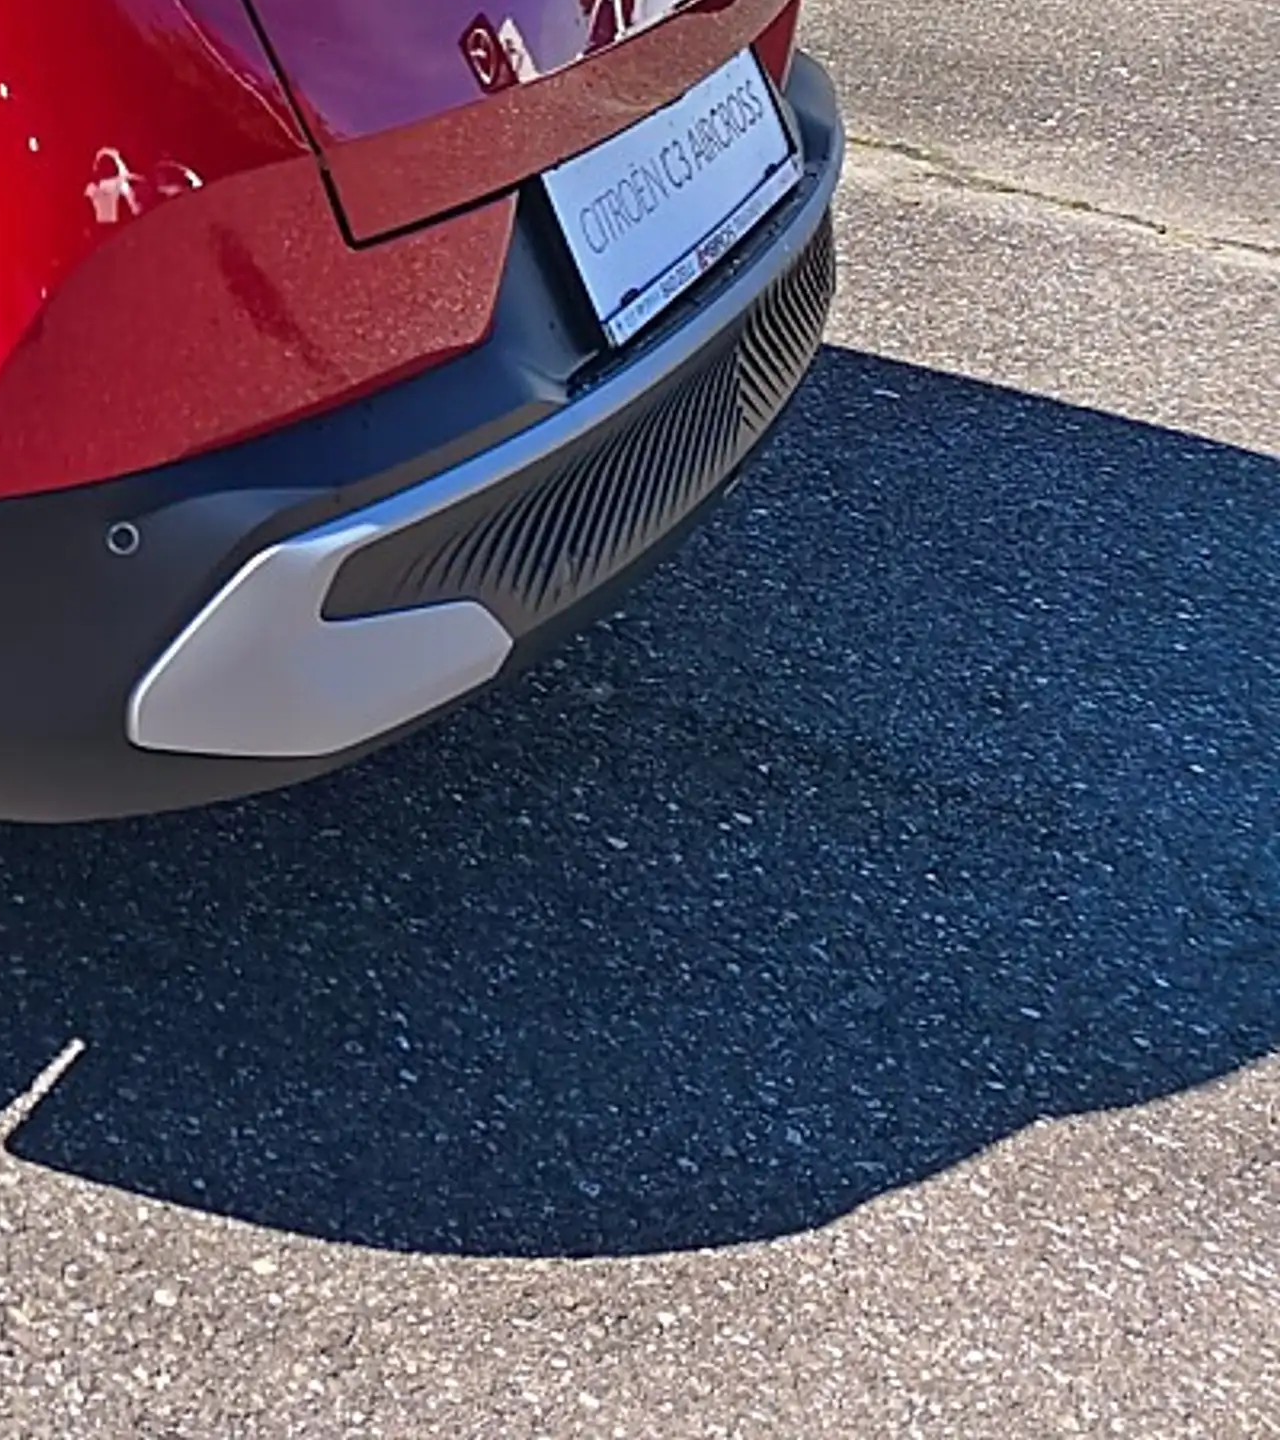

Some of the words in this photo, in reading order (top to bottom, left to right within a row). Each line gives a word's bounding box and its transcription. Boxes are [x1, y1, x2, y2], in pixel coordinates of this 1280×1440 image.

[578, 156, 671, 254] CITROËN
[659, 140, 693, 190] C3
[688, 79, 764, 172] AIRCROSS
